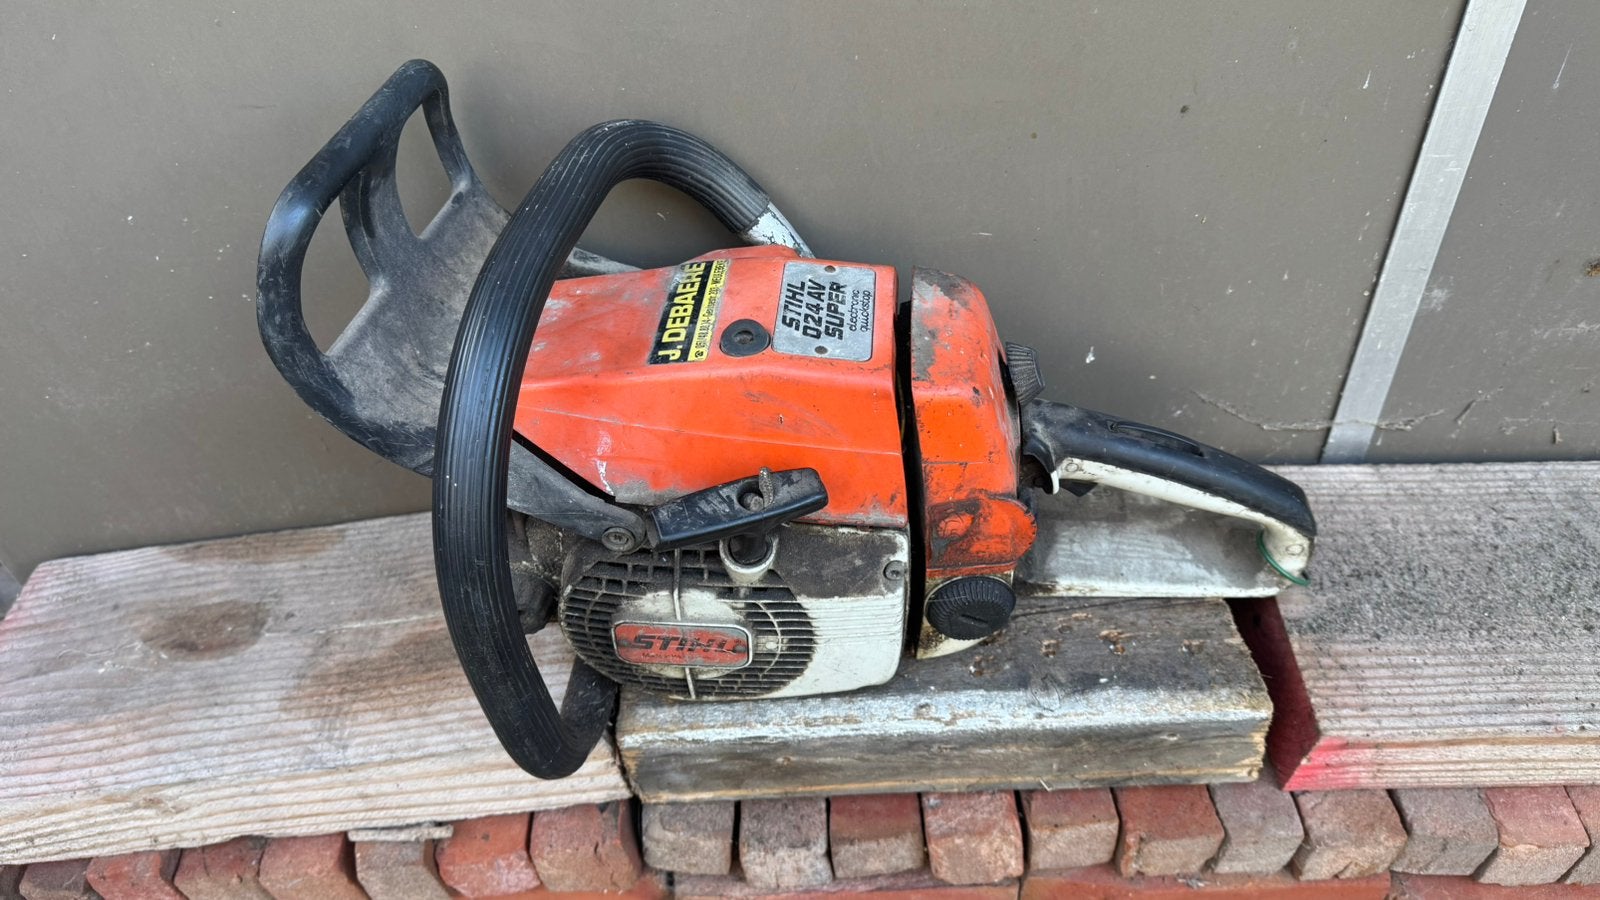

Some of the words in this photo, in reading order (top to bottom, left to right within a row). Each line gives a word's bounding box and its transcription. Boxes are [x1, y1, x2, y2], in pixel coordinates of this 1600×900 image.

[662, 262, 706, 343] DEBAERE
[782, 281, 806, 331] STIHL
[807, 278, 826, 302] AV
[824, 281, 847, 341] SUPER
[847, 289, 860, 332] electronic
[859, 290, 872, 333] quickstop
[802, 302, 824, 340] 024
[658, 345, 682, 361] J.
[629, 635, 735, 653] STIHL
